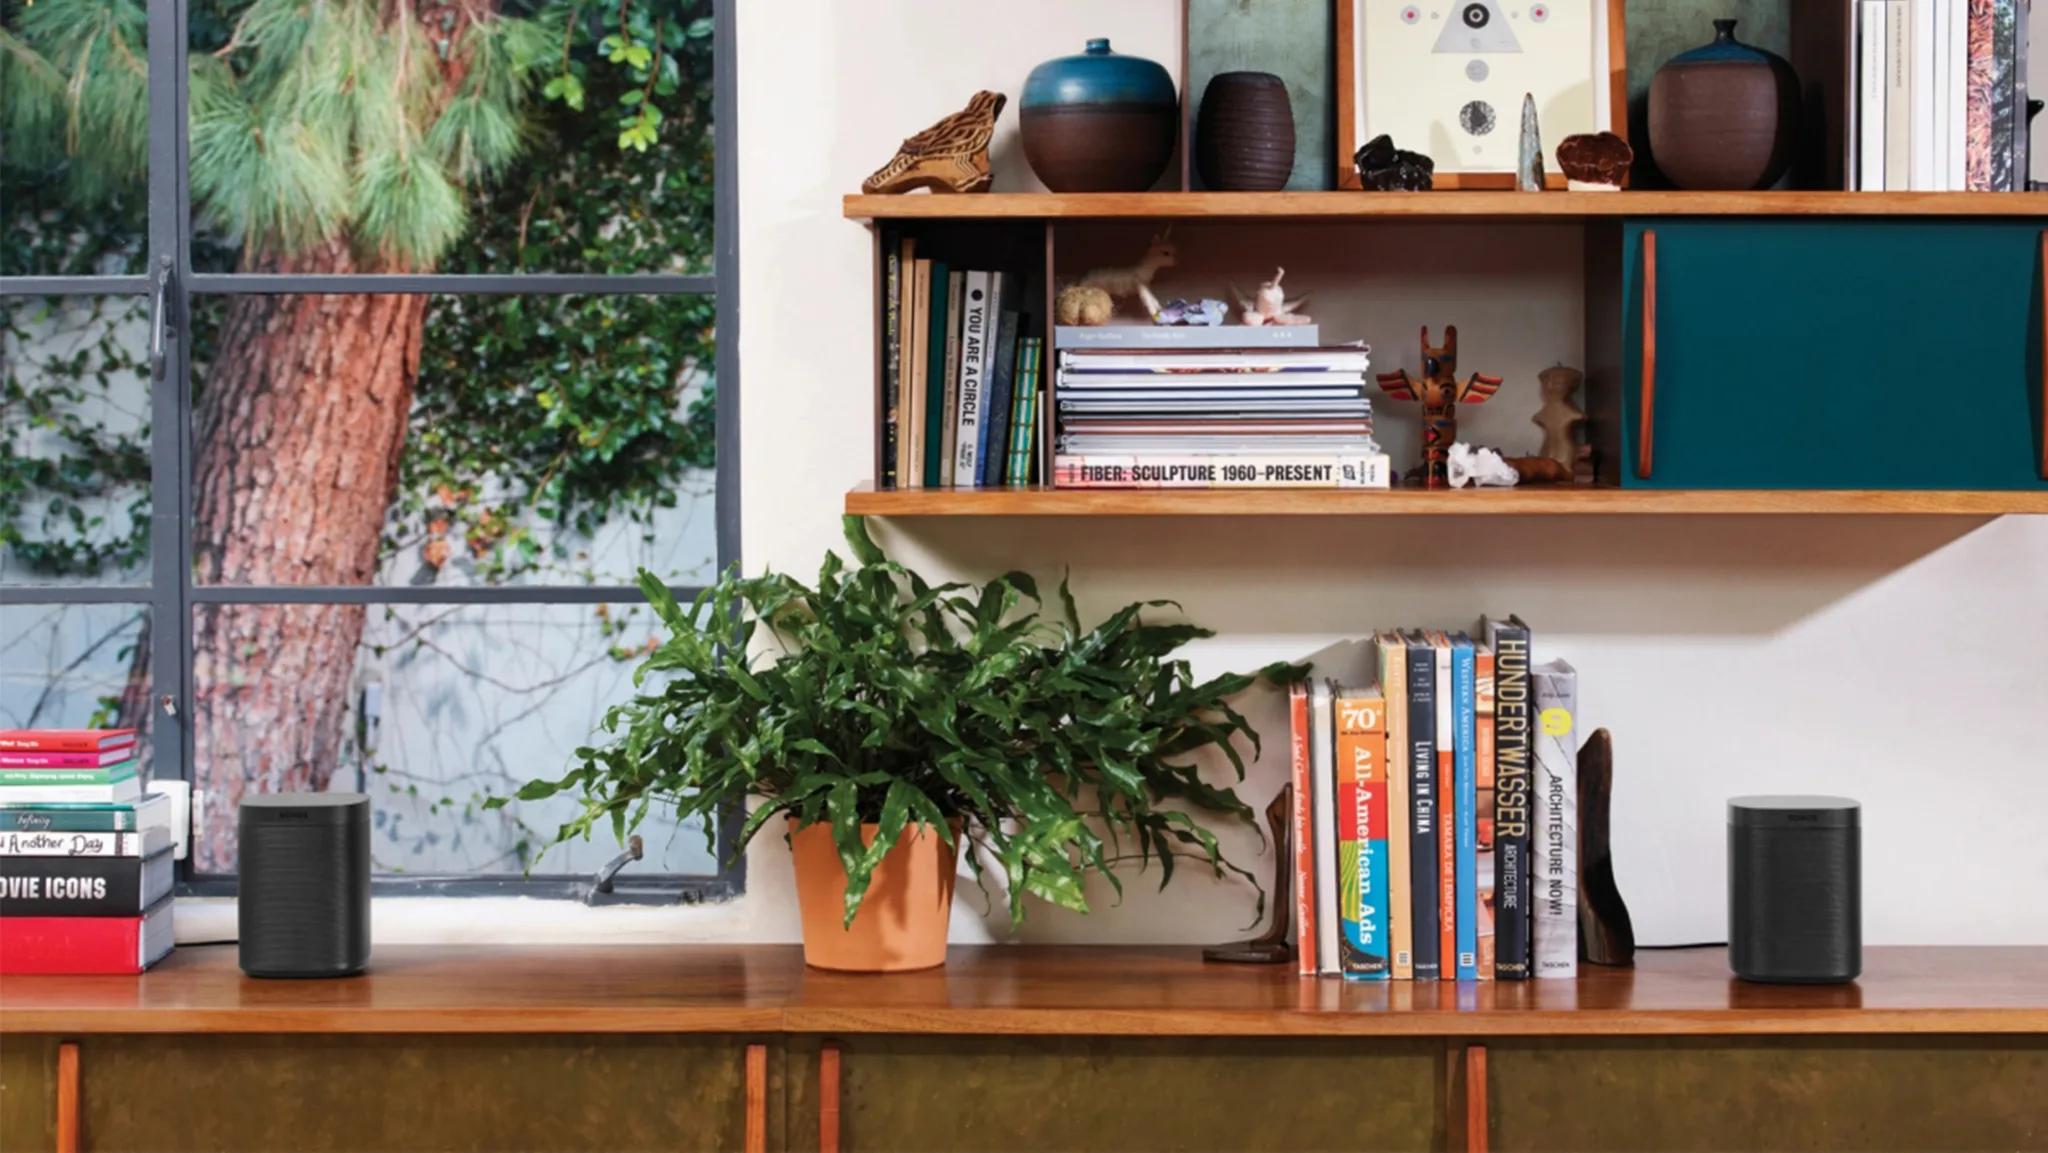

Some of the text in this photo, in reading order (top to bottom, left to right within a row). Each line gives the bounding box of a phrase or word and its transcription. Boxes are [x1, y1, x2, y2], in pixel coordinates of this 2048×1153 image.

[967, 306, 983, 334] YOU
[965, 337, 980, 364] ARE
[965, 366, 978, 377] A
[962, 379, 978, 427] CIRCLE
[1081, 465, 1127, 481] FIBER:
[1132, 465, 1217, 481] SCULPTURE
[1461, 657, 1471, 704] WESTERN
[1461, 706, 1471, 752] AMERICA
[1497, 639, 1527, 838] HUNDERTWASSER
[1541, 707, 1572, 736] 9
[1415, 740, 1433, 834] LIVING IN CHINA
[1355, 746, 1374, 895] All-American
[9, 834, 64, 854] Another
[68, 834, 104, 856] Day
[1548, 774, 1563, 916] ARCHITECTURE NOW!
[45, 876, 107, 899] ICONS
[1443, 812, 1453, 932] TAMARA DE LEMPICKA
[1504, 844, 1518, 910] ARCHITECTURE
[1359, 903, 1377, 945] Ads
[1496, 963, 1526, 971] TASCHEN
